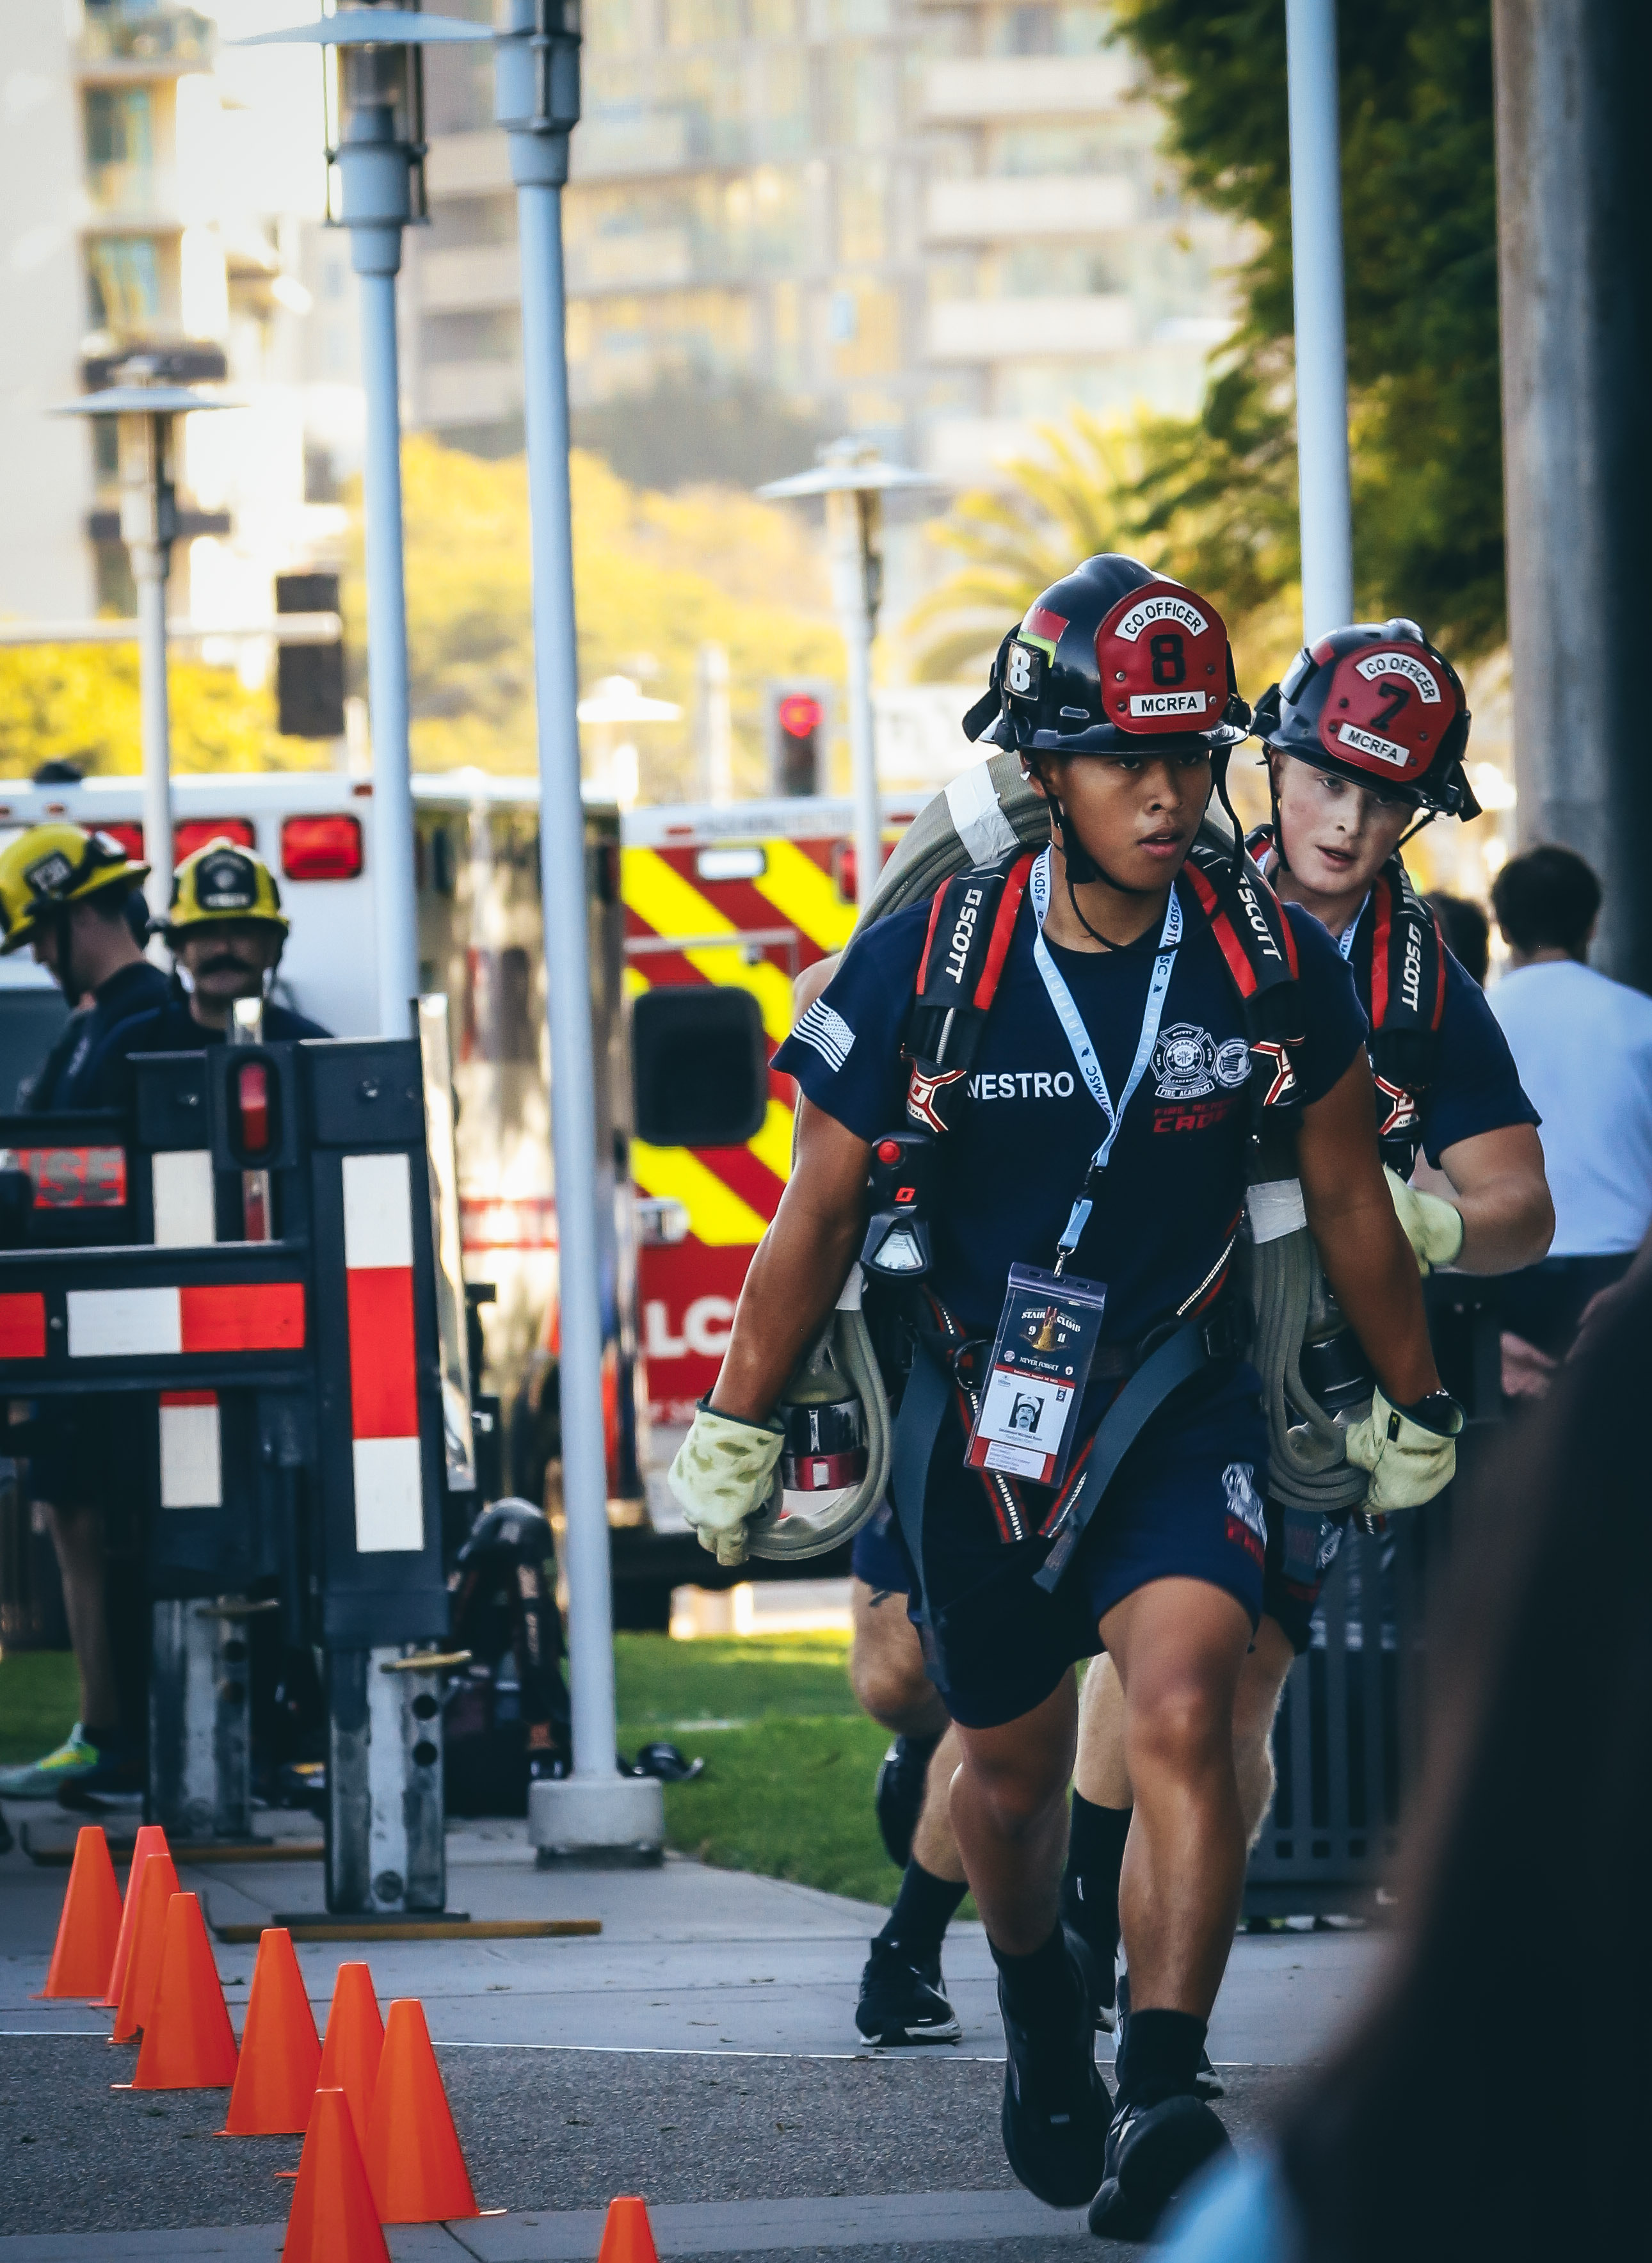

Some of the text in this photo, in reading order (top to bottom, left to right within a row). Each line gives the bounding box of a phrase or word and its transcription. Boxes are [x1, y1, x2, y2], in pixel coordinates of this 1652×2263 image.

[1125, 602, 1201, 634] CO OFFICER
[1010, 647, 1030, 692] 8
[1150, 634, 1186, 686] 8
[1367, 657, 1436, 699] CO OFFICER
[1141, 696, 1198, 712] MCRFA
[1370, 681, 1411, 732] 7
[1347, 730, 1398, 761] MCRFA
[1237, 886, 1283, 962] SCOTT
[945, 906, 977, 985] SCOTT
[1402, 940, 1422, 1012] SCOTT
[967, 1072, 1075, 1100] VESTRO
[1160, 1084, 1210, 1097] FIRE ACADEMY
[1028, 1325, 1036, 1335] 9
[1056, 1316, 1081, 1332] CLIMB
[1020, 1357, 1059, 1371] NEVER FORGET
